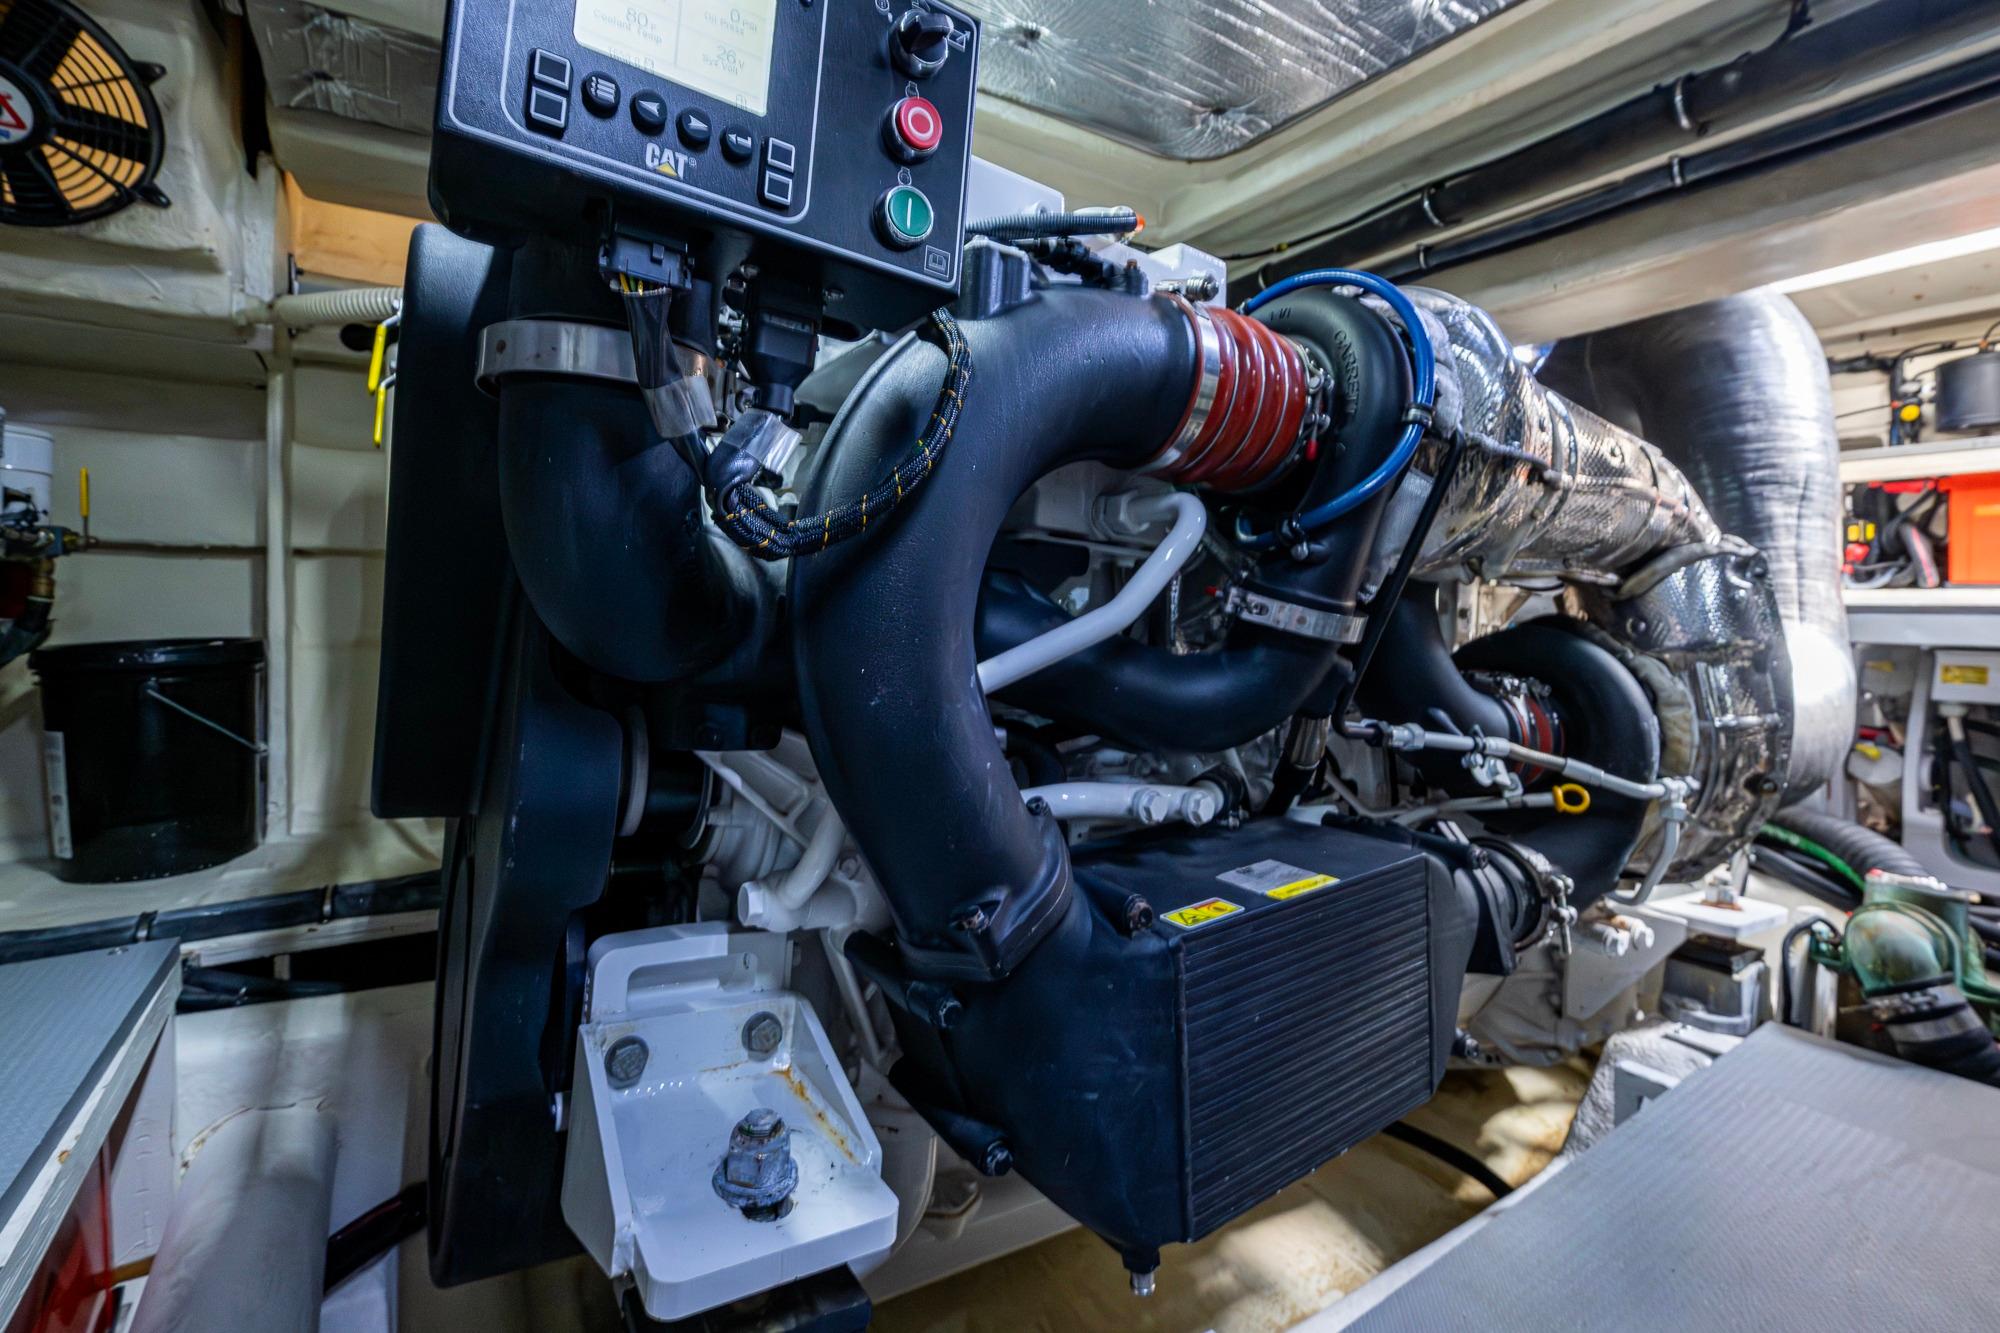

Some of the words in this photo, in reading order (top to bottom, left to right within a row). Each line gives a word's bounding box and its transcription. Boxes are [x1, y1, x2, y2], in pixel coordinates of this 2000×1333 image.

[626, 7, 648, 27] 80
[730, 8, 740, 23] 0
[717, 45, 736, 65] 26
